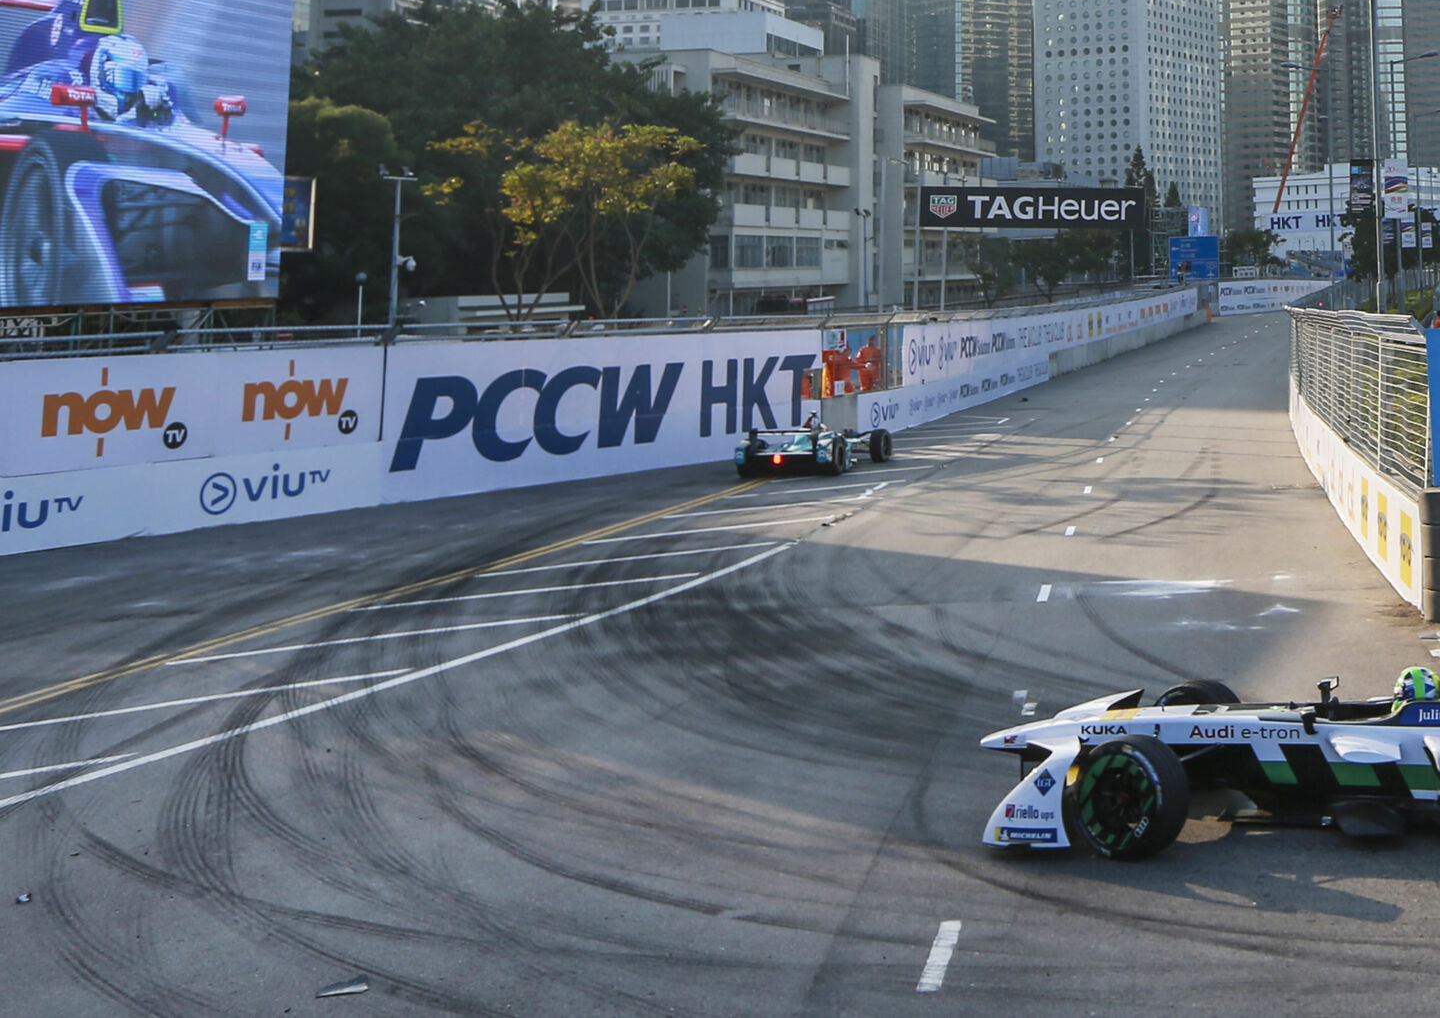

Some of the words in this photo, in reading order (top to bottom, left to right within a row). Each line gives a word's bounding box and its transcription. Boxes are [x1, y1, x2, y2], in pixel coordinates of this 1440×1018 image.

[1270, 215, 1302, 230] HKT
[241, 377, 349, 423] now
[338, 414, 356, 430] TV
[40, 386, 177, 438] now
[165, 427, 187, 444] TV
[389, 362, 684, 473] PCCW
[700, 354, 817, 438] HKT
[1081, 725, 1128, 736] KUKA
[1189, 724, 1236, 740] Audi
[1240, 725, 1301, 740] e-tron
[1015, 804, 1040, 820] riello
[1040, 811, 1055, 822] ups
[1009, 831, 1053, 839] MICHELIN
